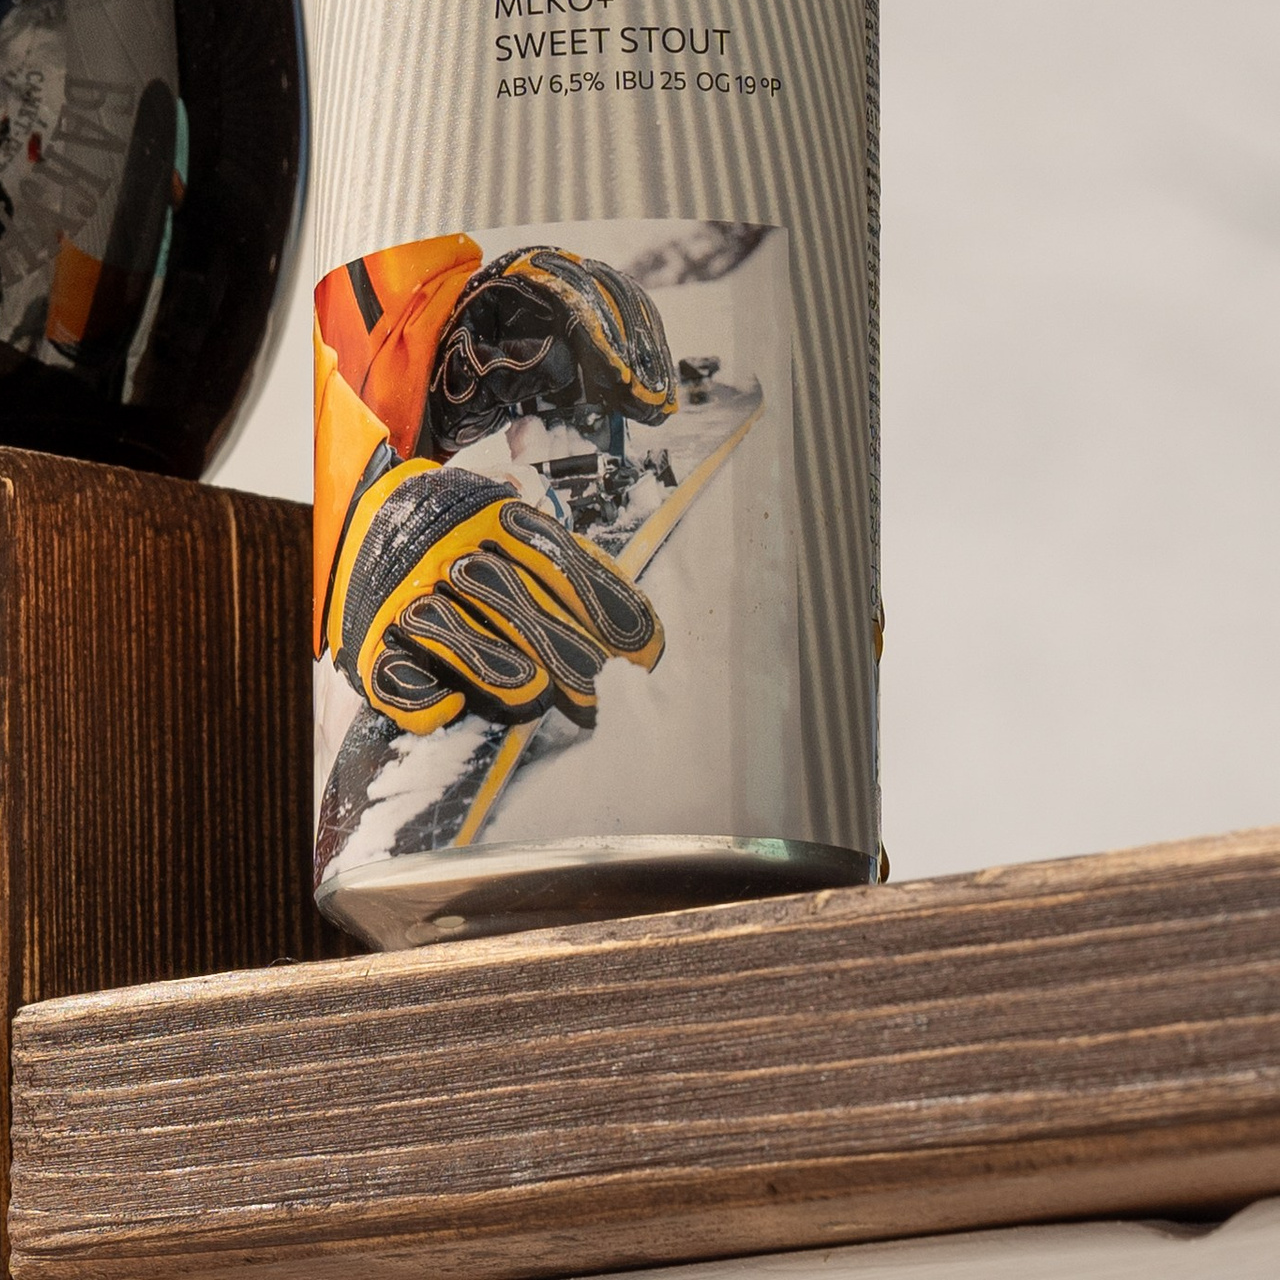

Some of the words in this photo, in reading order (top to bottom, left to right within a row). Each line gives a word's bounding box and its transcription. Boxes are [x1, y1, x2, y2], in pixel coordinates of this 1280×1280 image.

[495, 27, 610, 61] SWEET
[620, 26, 731, 56] STOUT
[496, 75, 543, 99] ABV
[549, 71, 605, 96] 6,5%
[615, 70, 654, 91] IBU
[660, 71, 687, 91] 25
[696, 71, 731, 93] OG
